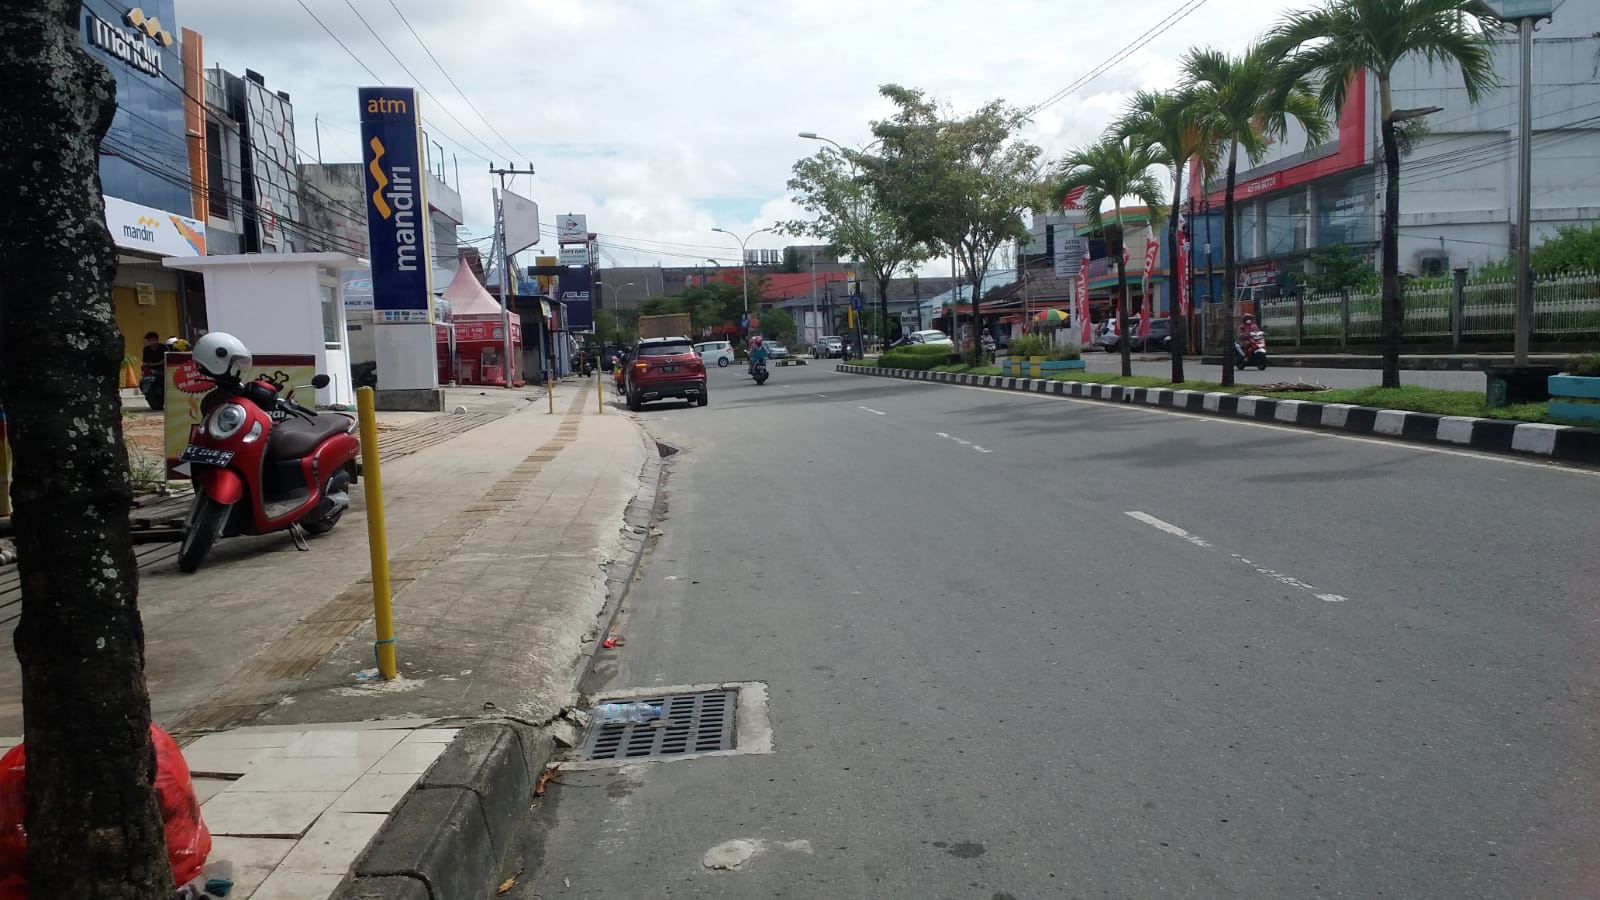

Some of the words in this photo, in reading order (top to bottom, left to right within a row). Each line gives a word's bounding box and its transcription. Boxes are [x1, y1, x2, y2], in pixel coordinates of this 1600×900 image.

[93, 16, 162, 77] mandiri
[367, 97, 407, 114] atm
[123, 223, 154, 243] mandiri
[387, 166, 418, 272] mandiri
